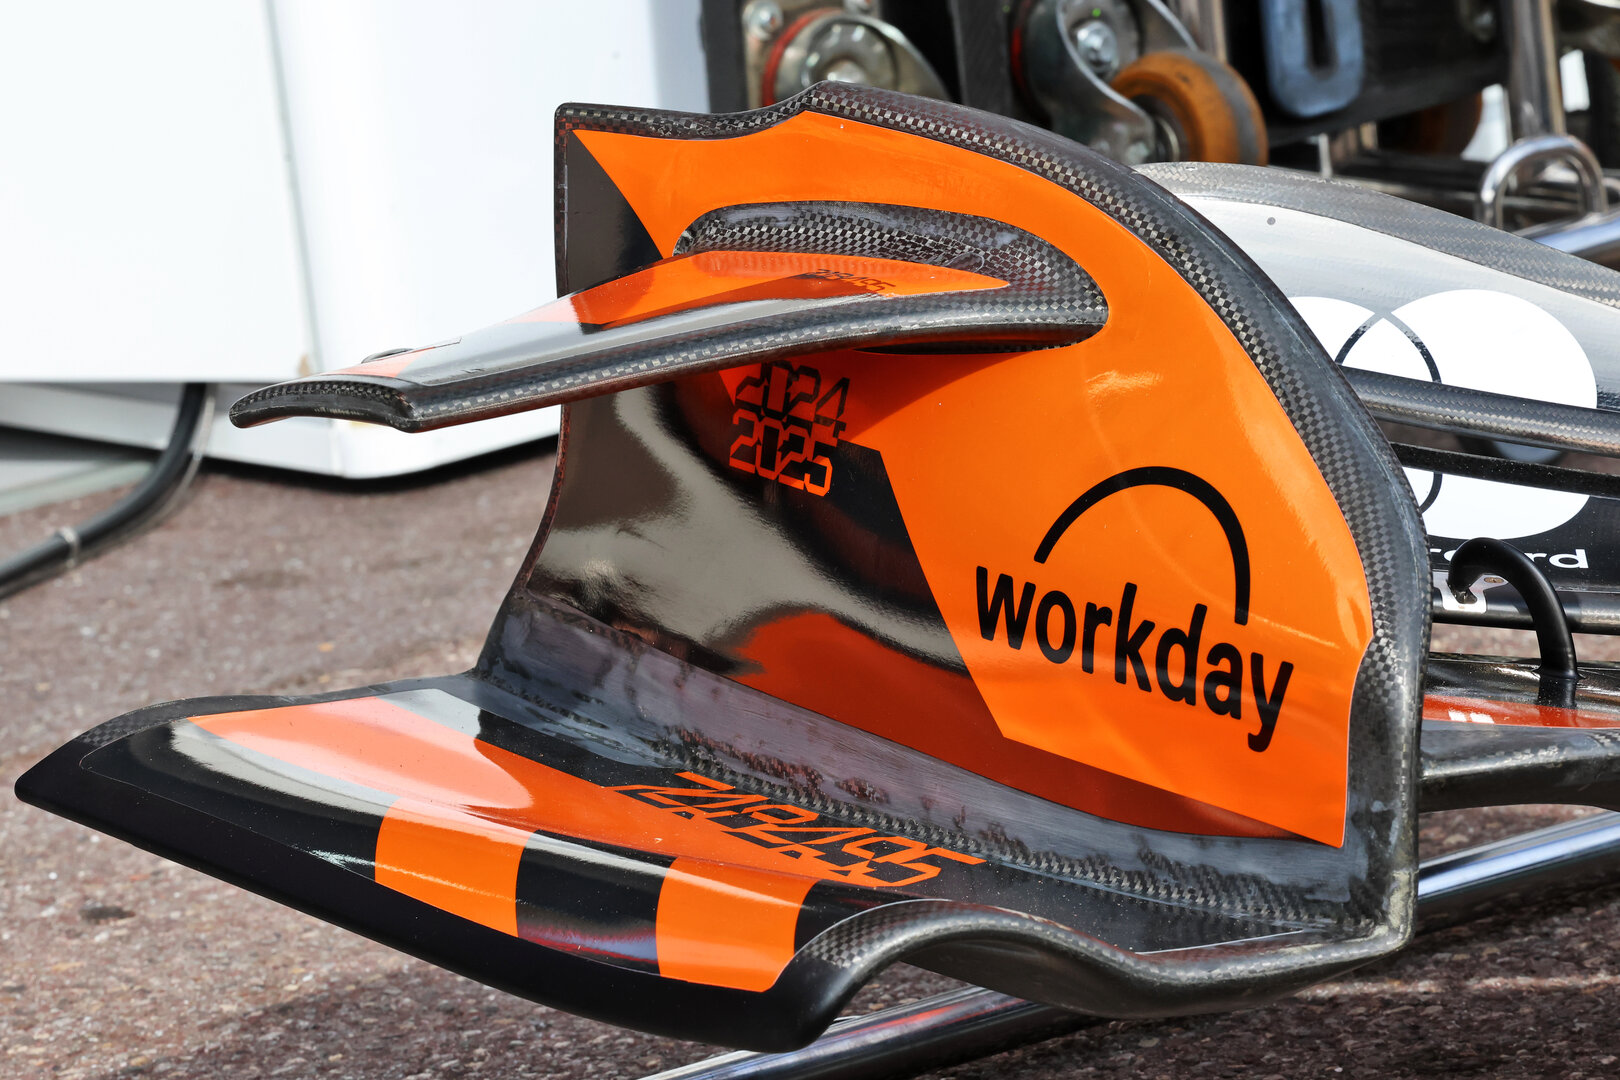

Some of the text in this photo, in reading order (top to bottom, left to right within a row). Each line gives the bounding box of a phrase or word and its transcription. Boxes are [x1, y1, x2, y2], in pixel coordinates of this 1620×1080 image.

[735, 360, 850, 439] 2024
[729, 408, 839, 497] 2025
[976, 565, 1294, 752] workday
